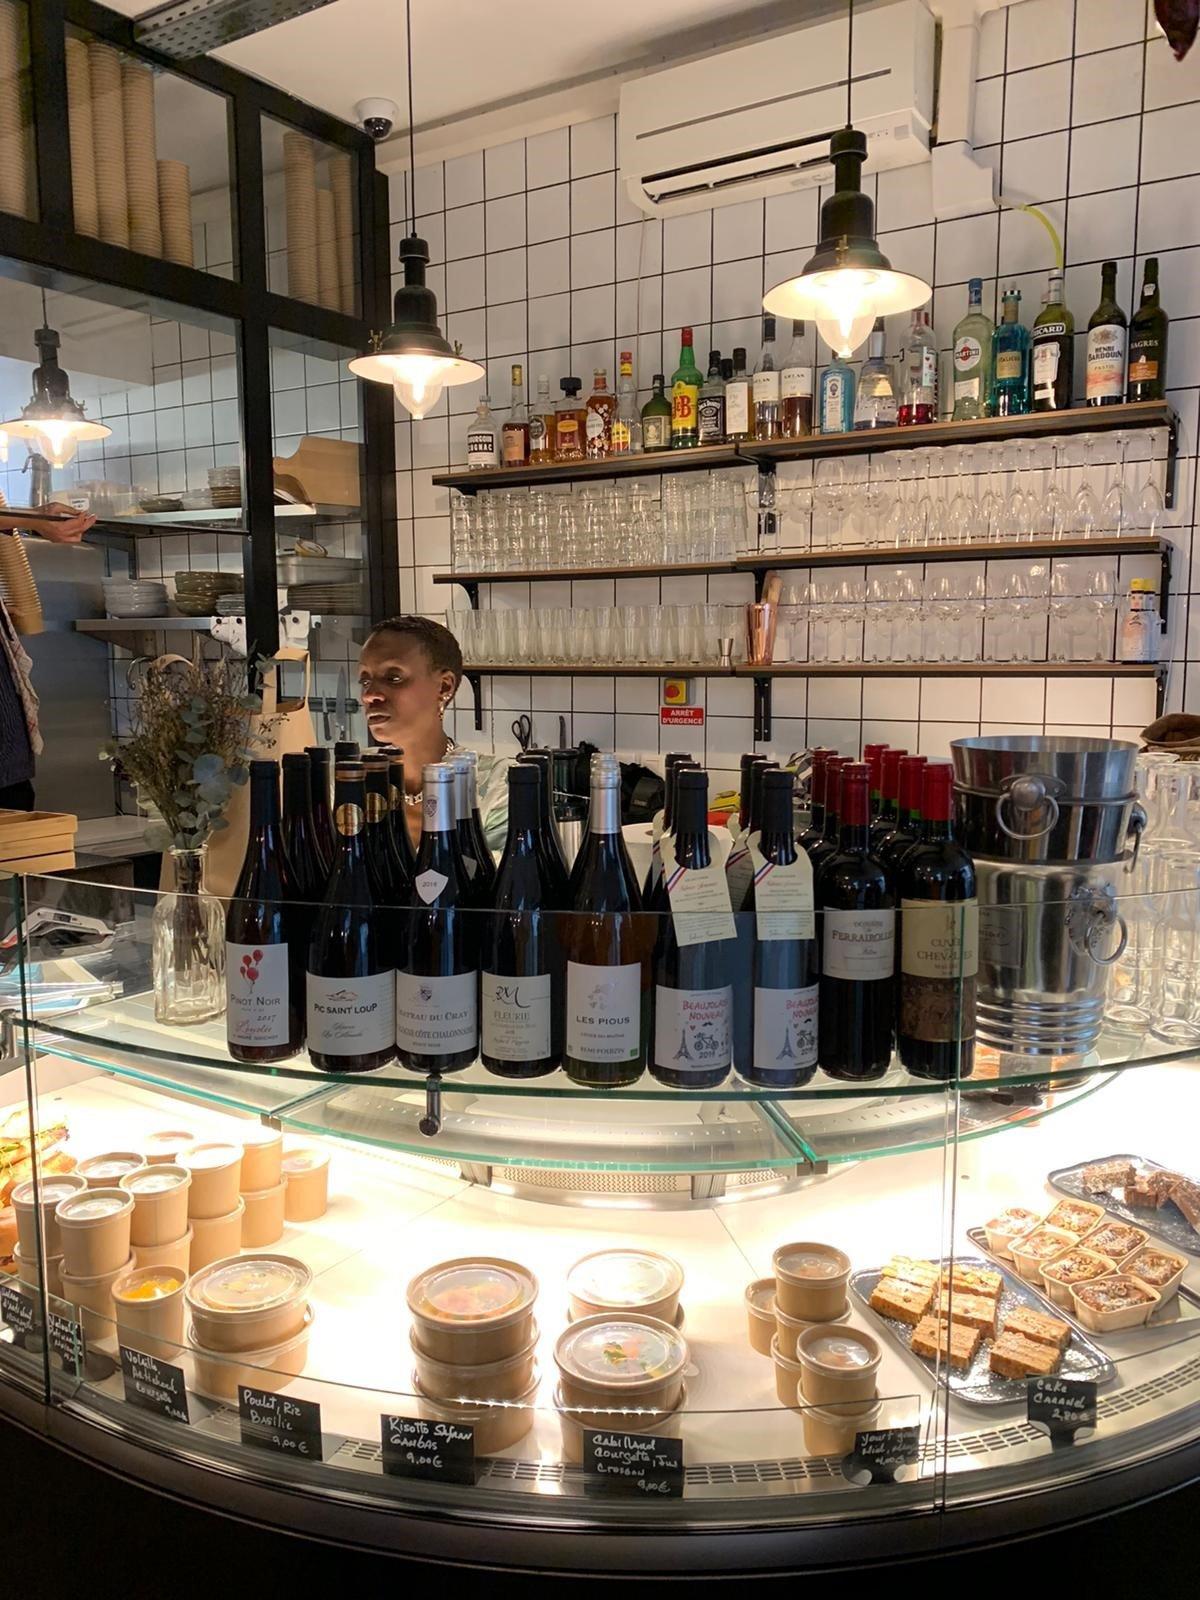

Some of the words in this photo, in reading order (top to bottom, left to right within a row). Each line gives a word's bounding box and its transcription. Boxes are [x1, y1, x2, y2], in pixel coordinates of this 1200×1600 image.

[955, 348, 980, 359] MARTINI
[256, 996, 281, 1006] NOIR
[313, 1003, 325, 1014] PIC
[326, 1006, 352, 1015] SAINT
[354, 1003, 378, 1014] LOUP
[576, 1015, 595, 1025] LES
[598, 1016, 631, 1025] PIOUS
[1036, 1379, 1068, 1393] Cake
[283, 1401, 302, 1417] Riz
[389, 1415, 430, 1434] Risotto
